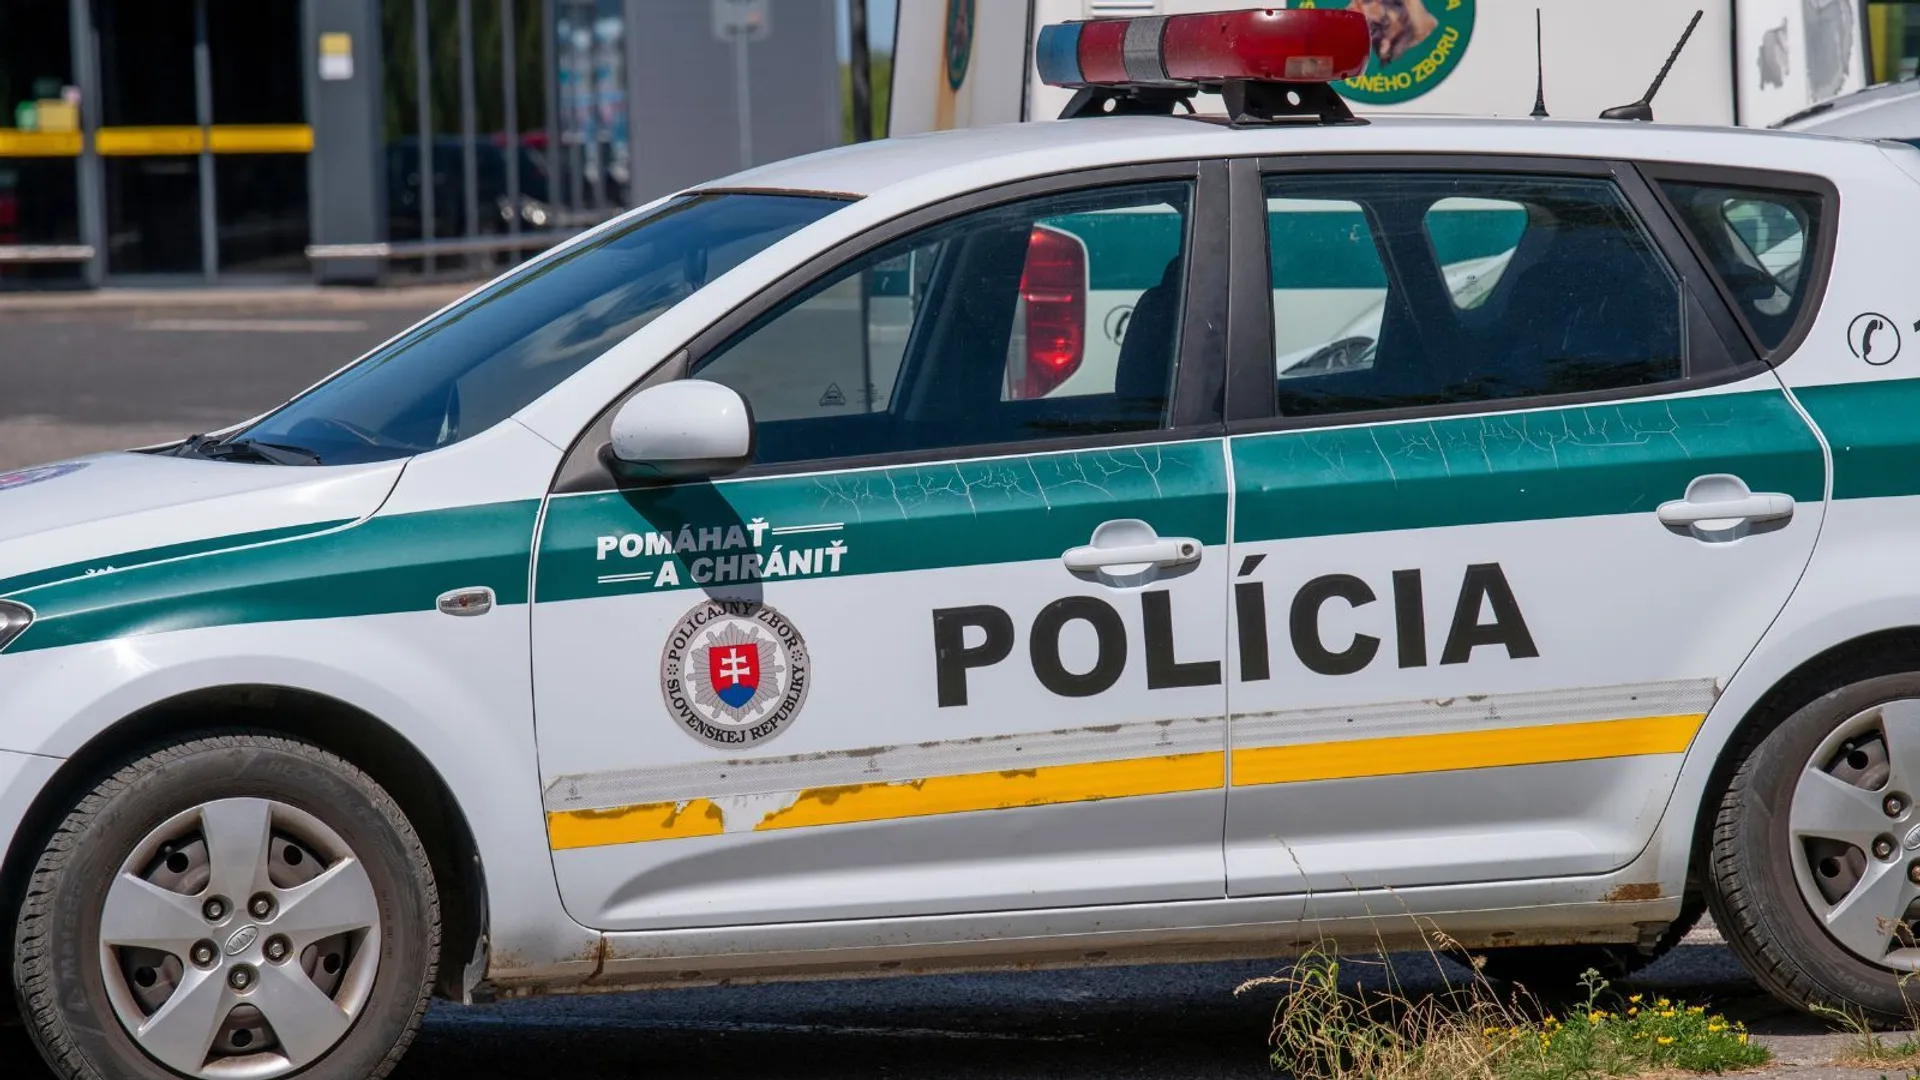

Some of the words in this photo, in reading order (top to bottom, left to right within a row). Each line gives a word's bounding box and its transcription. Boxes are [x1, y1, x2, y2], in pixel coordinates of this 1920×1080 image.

[1411, 26, 1459, 82] ZBORU
[596, 517, 769, 560] POMÁHAŤ
[654, 560, 680, 587] A
[690, 539, 848, 584] CHRÁNIŤ
[758, 606, 799, 651] ZBOR
[932, 553, 1540, 708] POLÍCIA
[667, 678, 746, 743] SLOVENSKEJ
[750, 664, 805, 740] REPUBLIKY
